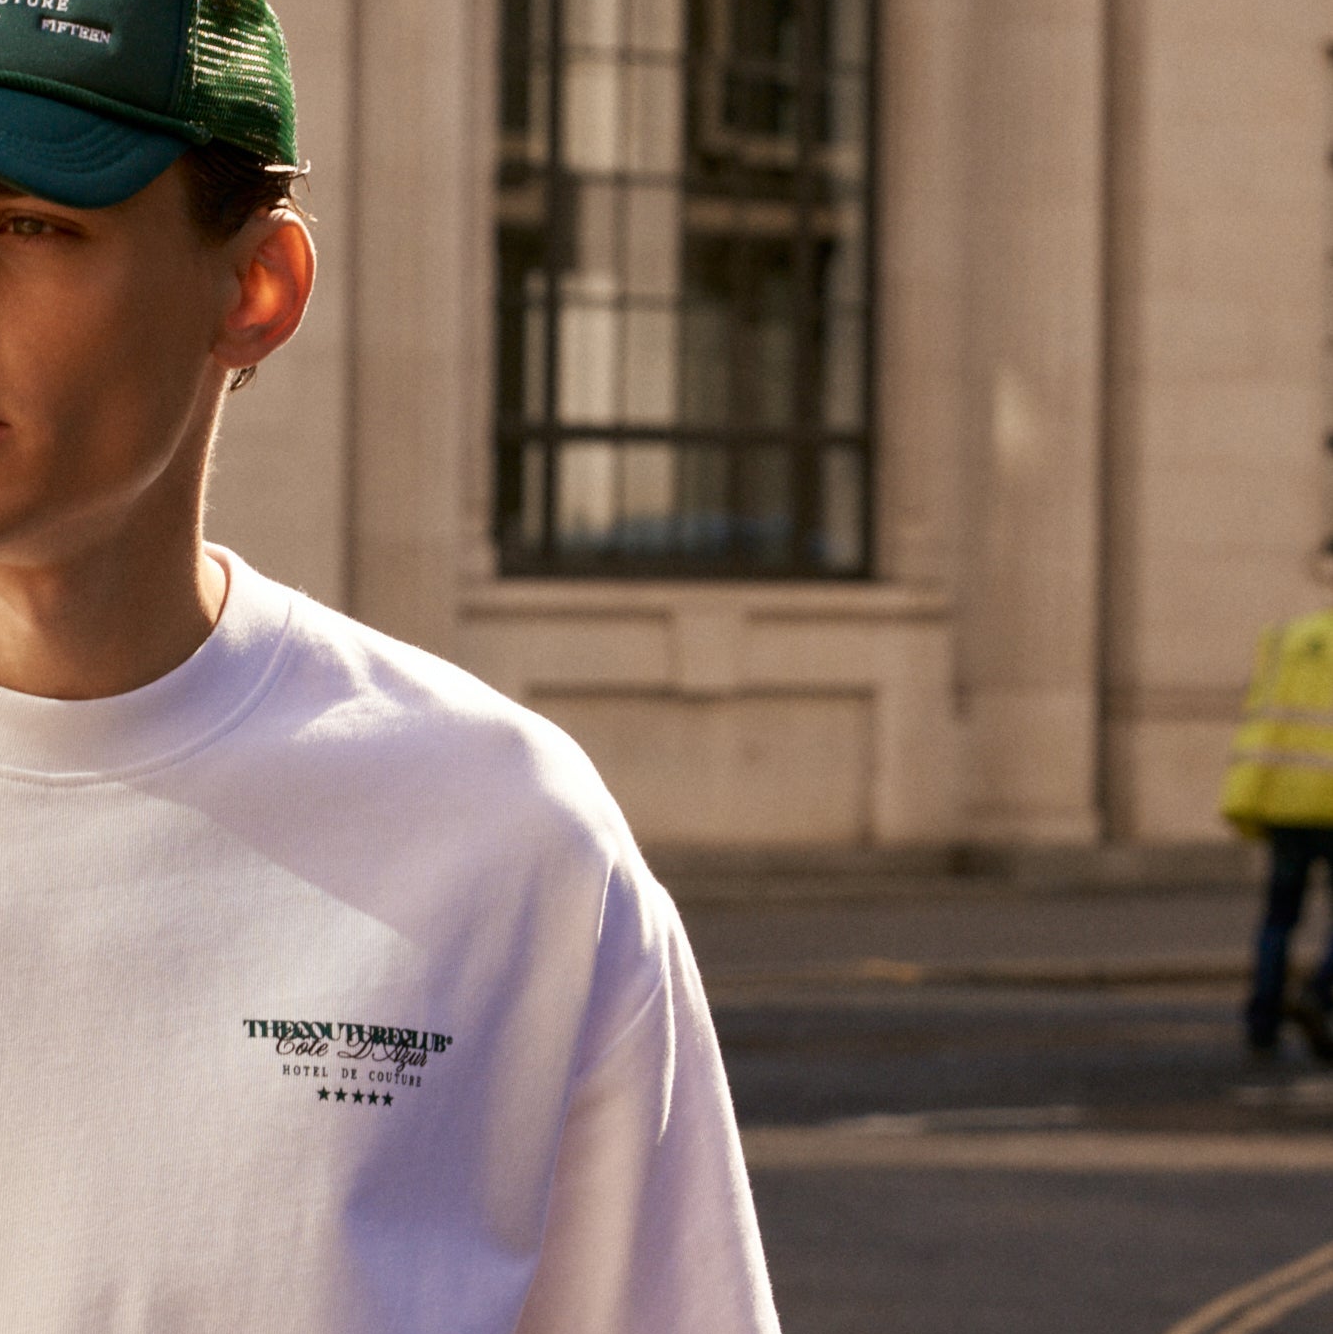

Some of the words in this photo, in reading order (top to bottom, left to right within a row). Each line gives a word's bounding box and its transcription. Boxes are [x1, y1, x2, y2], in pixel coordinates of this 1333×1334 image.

[41, 18, 112, 44] FIFTEEN
[282, 1065, 329, 1078] HOTEL
[341, 1068, 358, 1080] DE
[368, 1070, 423, 1088] COUTURE
